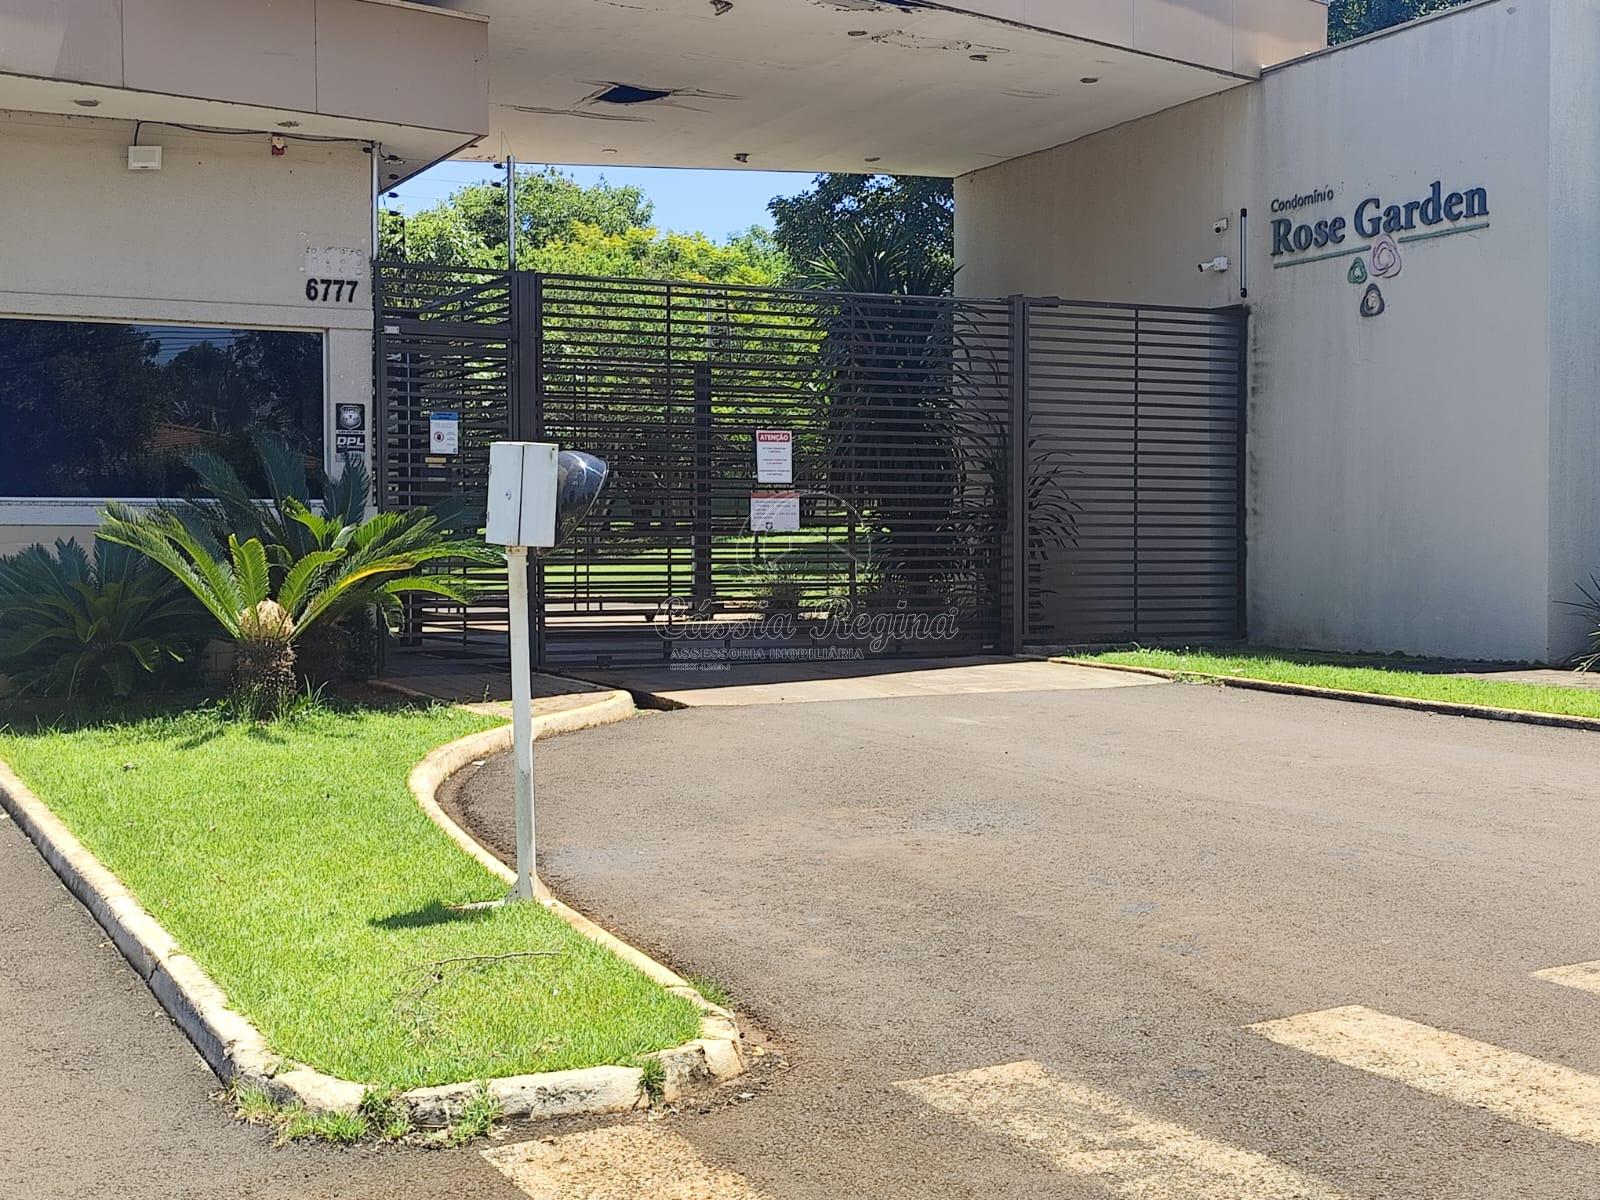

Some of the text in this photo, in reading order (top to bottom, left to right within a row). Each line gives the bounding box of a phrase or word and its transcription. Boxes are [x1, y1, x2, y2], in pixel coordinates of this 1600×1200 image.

[1270, 181, 1490, 256] Rose Garden
[305, 278, 358, 303] 6777
[336, 436, 365, 446] DPL
[759, 433, 789, 442] ATENÇÃO
